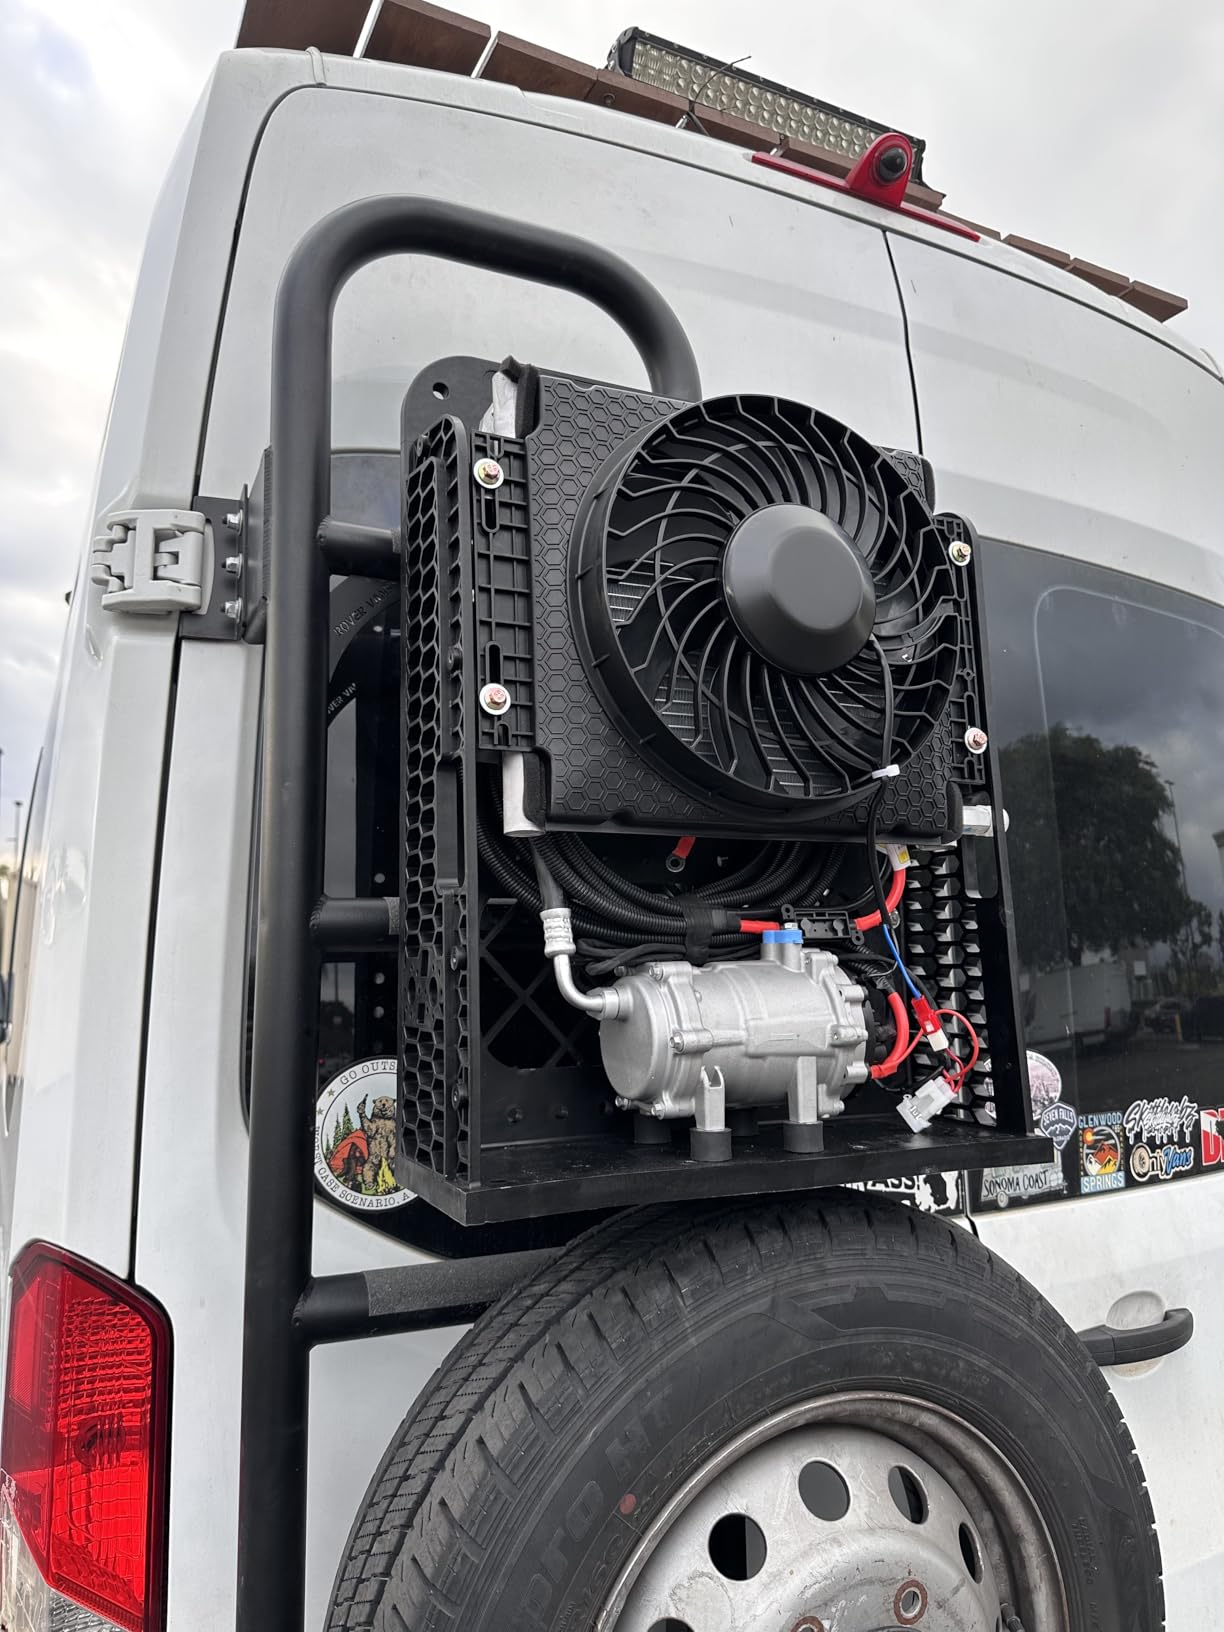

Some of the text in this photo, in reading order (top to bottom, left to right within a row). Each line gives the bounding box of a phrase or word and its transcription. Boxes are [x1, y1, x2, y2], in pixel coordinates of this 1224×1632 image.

[327, 695, 345, 715] VER
[339, 1060, 397, 1086] GO OUTS
[1043, 1108, 1073, 1126] SEVEN FALLS
[1078, 1112, 1122, 1128] GLENWOOD
[983, 1170, 1048, 1198] SONOMA COAST
[1081, 1172, 1124, 1193] SPRINGS
